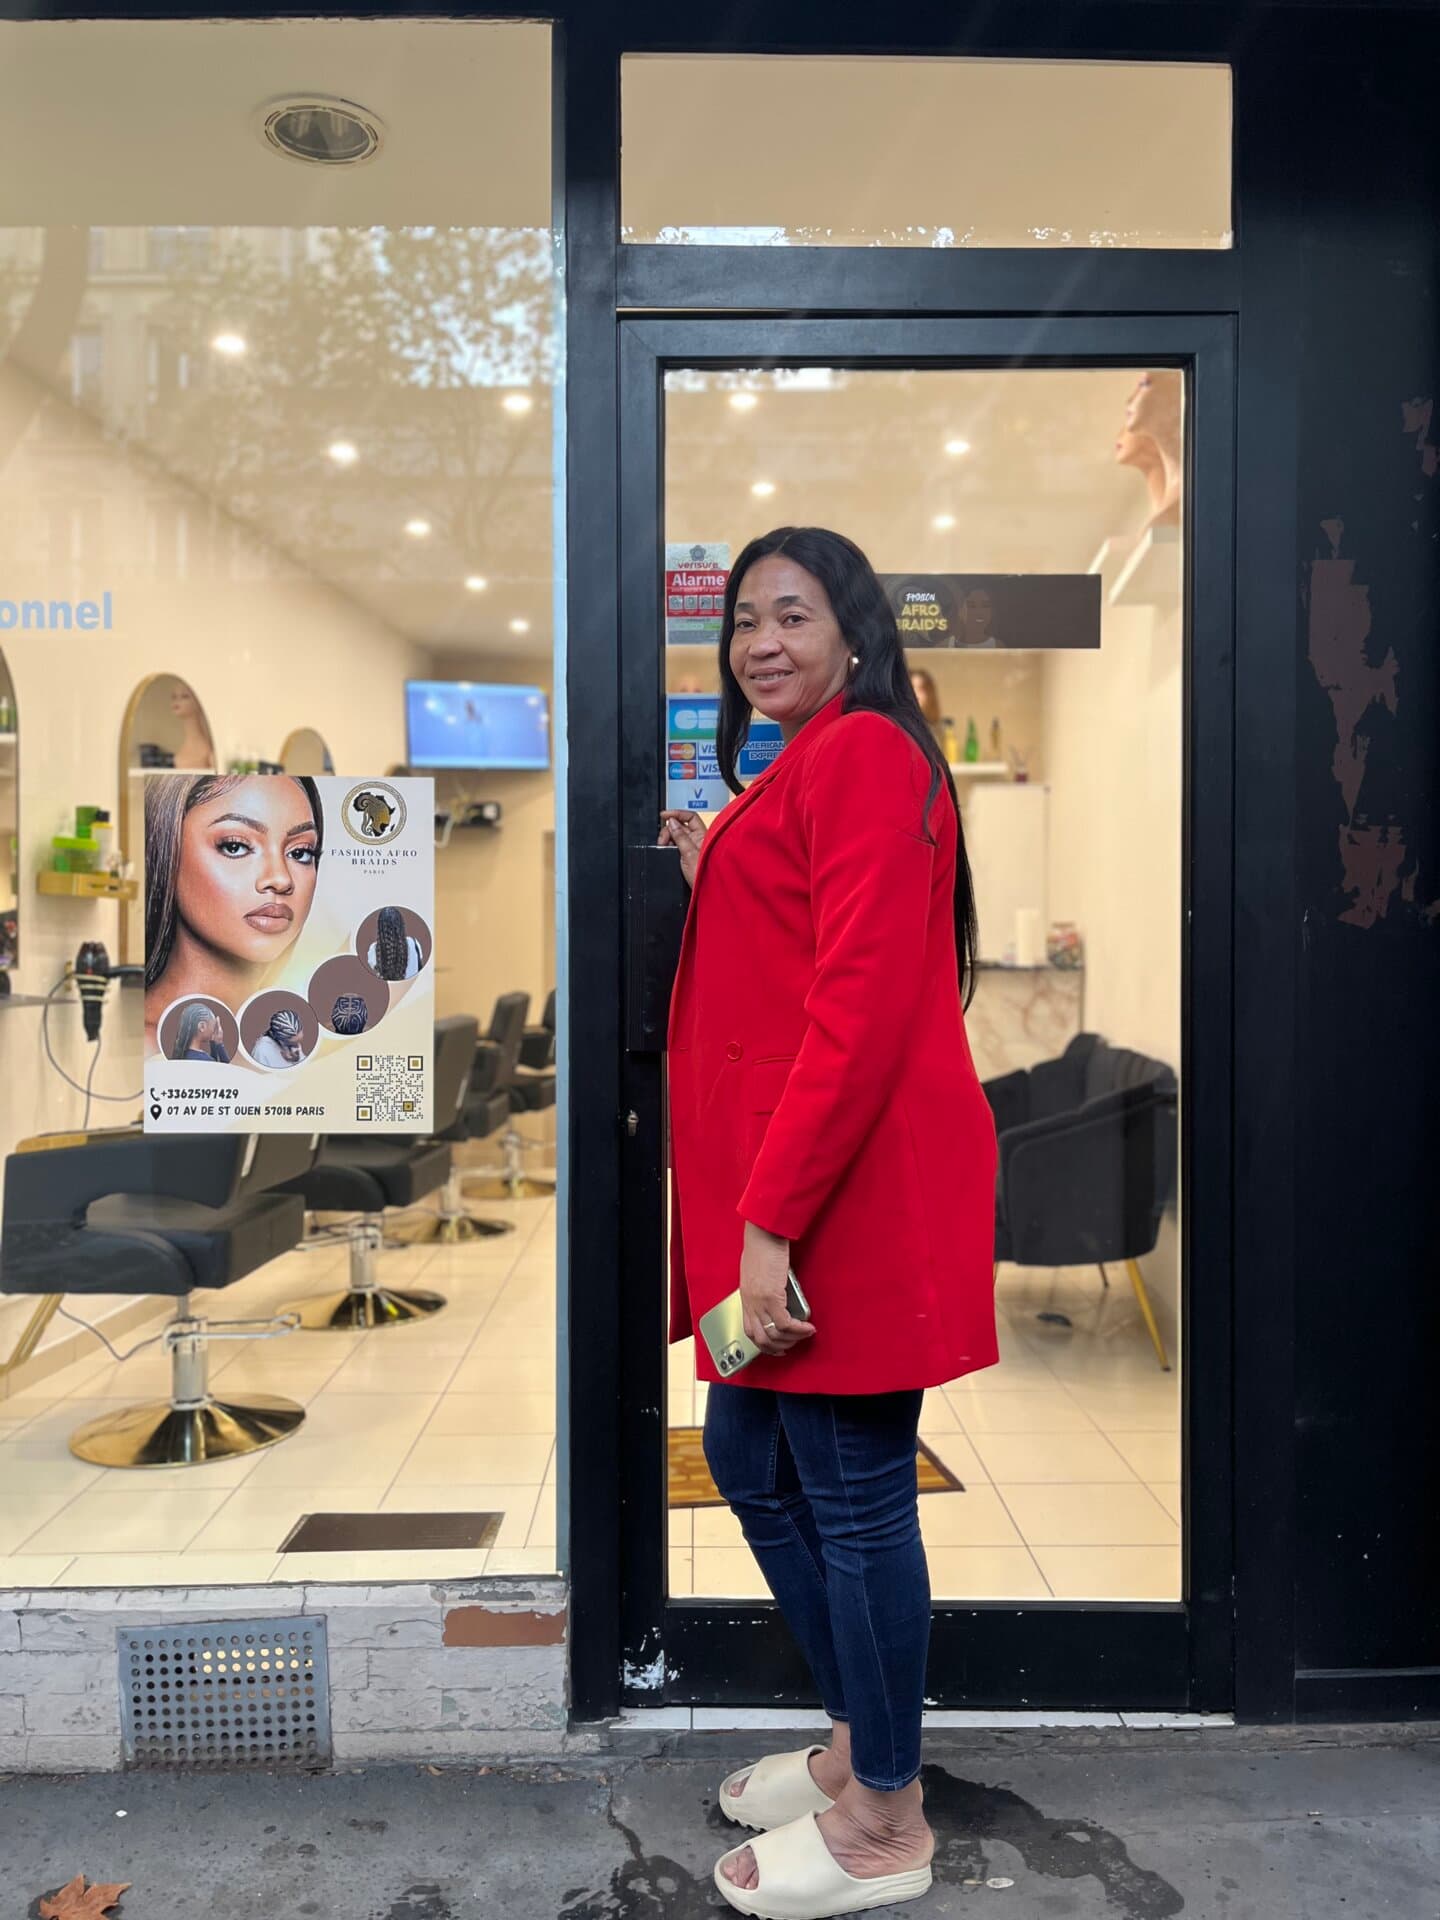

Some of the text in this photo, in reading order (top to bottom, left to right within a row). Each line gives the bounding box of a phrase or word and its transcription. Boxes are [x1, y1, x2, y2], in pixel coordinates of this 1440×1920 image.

[678, 561, 719, 569] verisure
[672, 572, 725, 586] Alarme
[901, 603, 940, 616] AFRO
[701, 743, 717, 754] VIS
[701, 763, 720, 773] VIS
[331, 848, 418, 857] FASHION AFRO
[351, 858, 398, 866] BRAIDS
[160, 1088, 239, 1099] +33625197429
[167, 1106, 325, 1115] 07 AV DE ST OUEN 57018 PARIS
